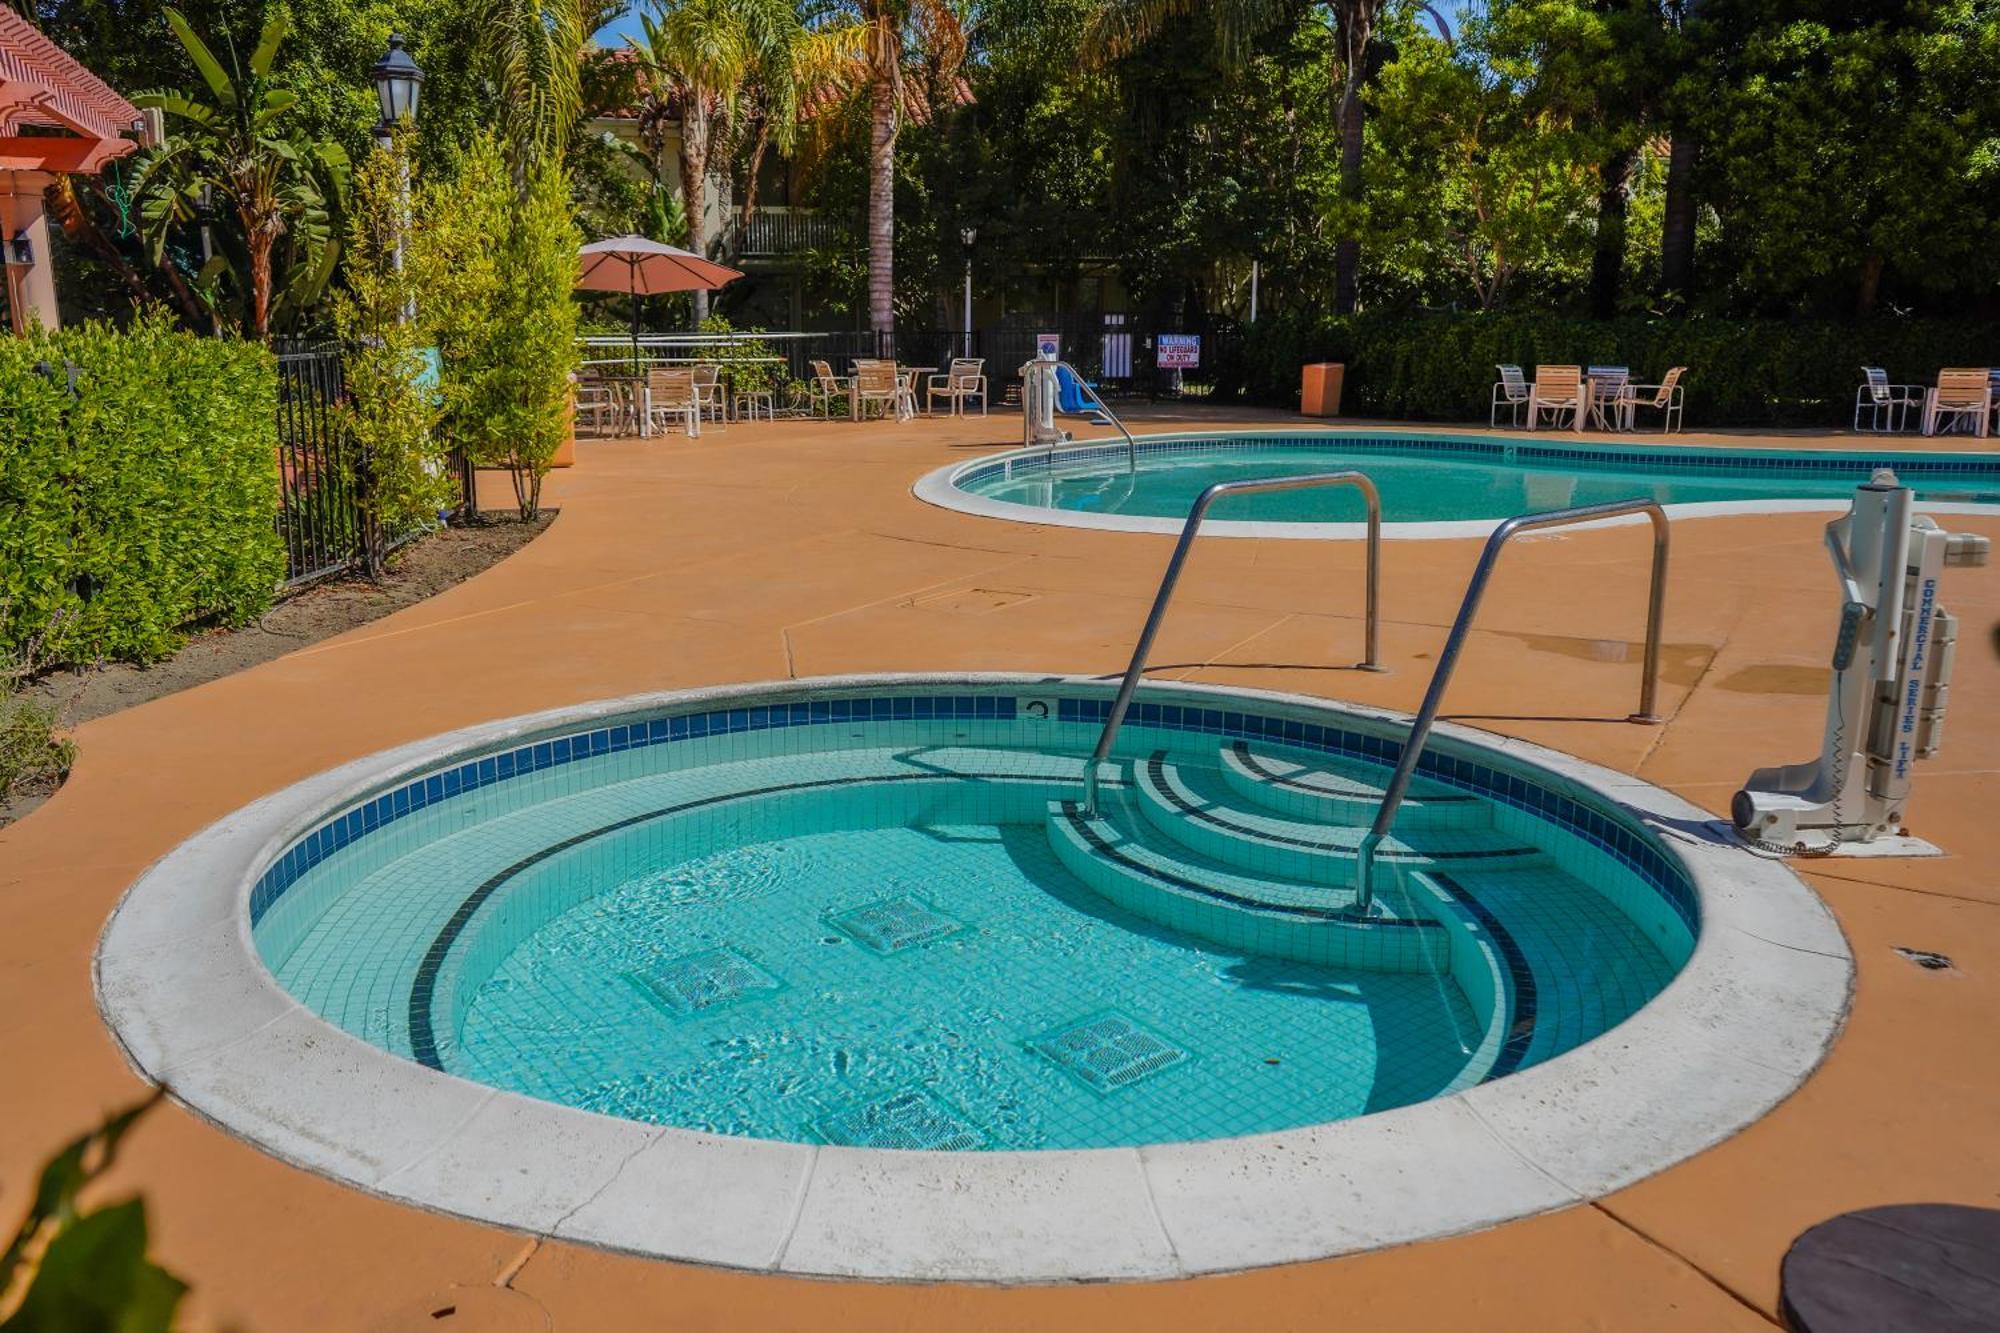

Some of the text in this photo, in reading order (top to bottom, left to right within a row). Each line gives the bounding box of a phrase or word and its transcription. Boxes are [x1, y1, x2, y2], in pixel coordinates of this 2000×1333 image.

[1162, 335, 1197, 346] WARNING
[1176, 354, 1190, 362] DUTY
[1910, 579, 1936, 671] COMMERCIAL
[1903, 679, 1919, 733] SERIES
